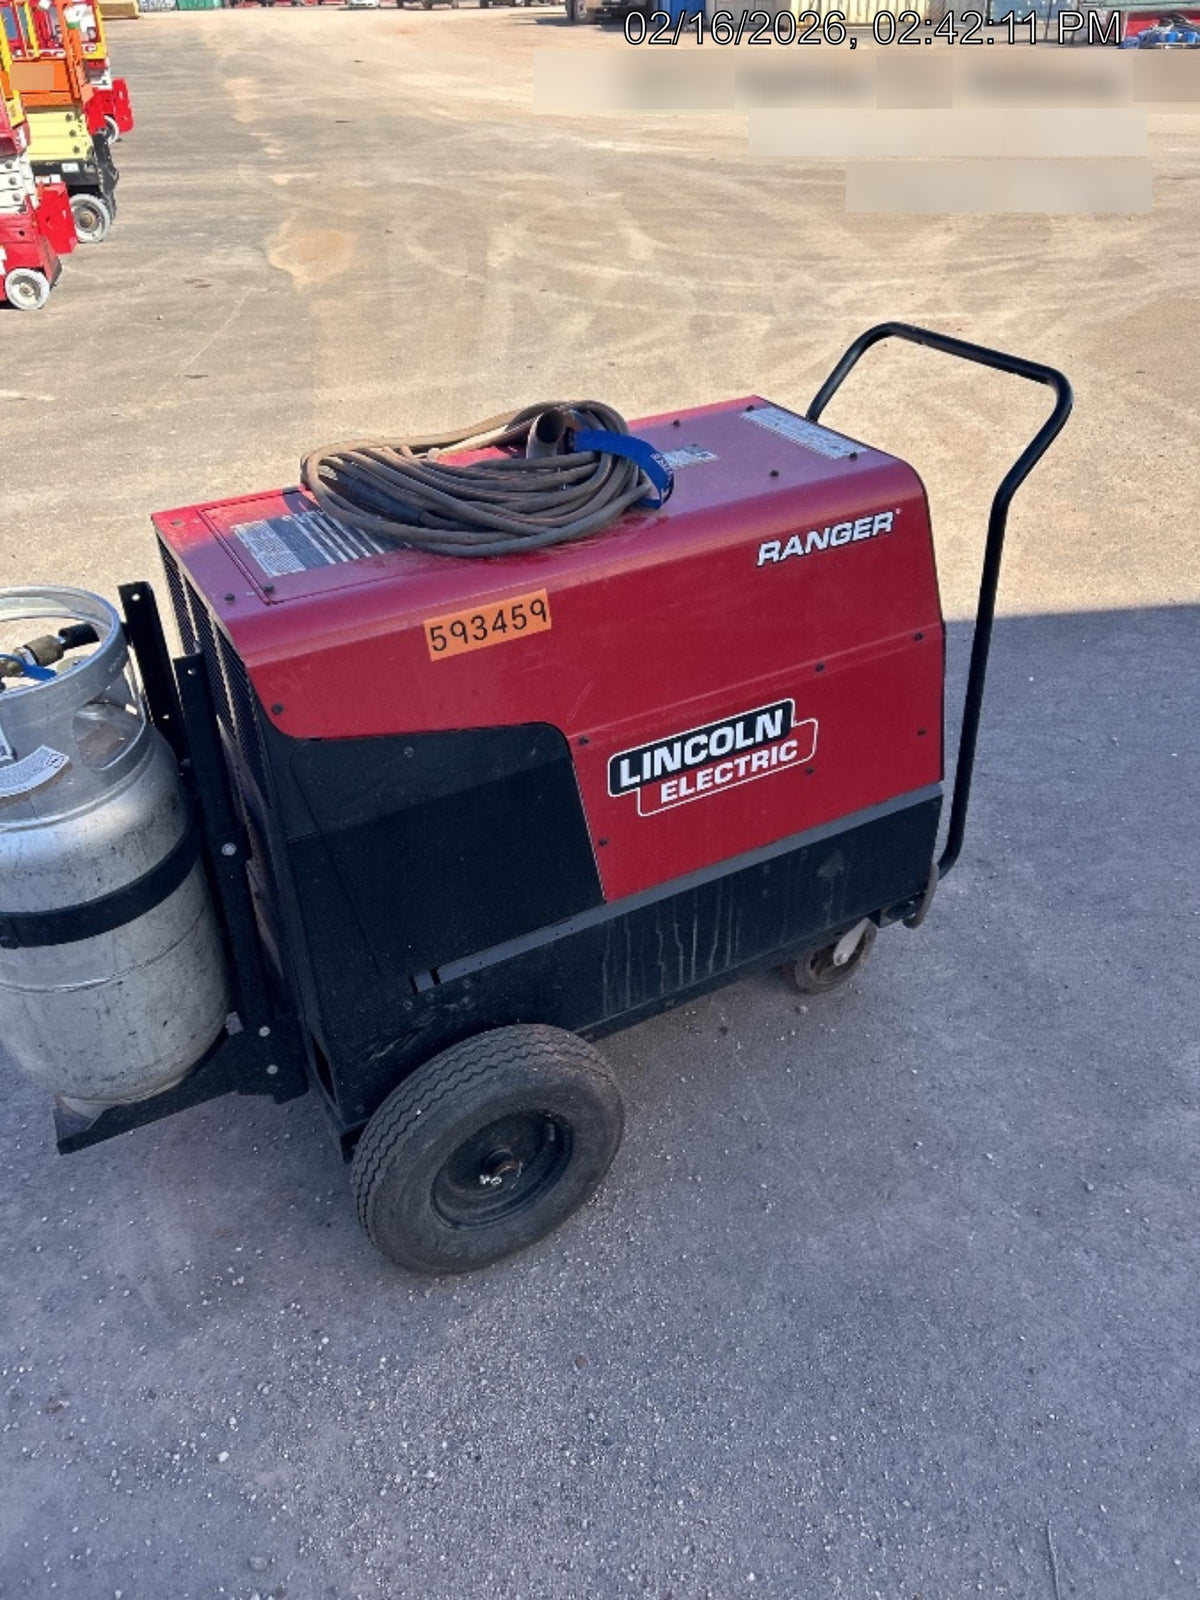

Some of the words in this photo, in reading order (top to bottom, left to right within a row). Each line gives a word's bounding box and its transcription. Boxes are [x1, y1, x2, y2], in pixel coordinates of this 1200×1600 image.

[757, 511, 894, 567] RANGER
[429, 598, 547, 652] 593459
[619, 709, 783, 788] LINCOLN
[660, 739, 798, 804] ELECTRIC
